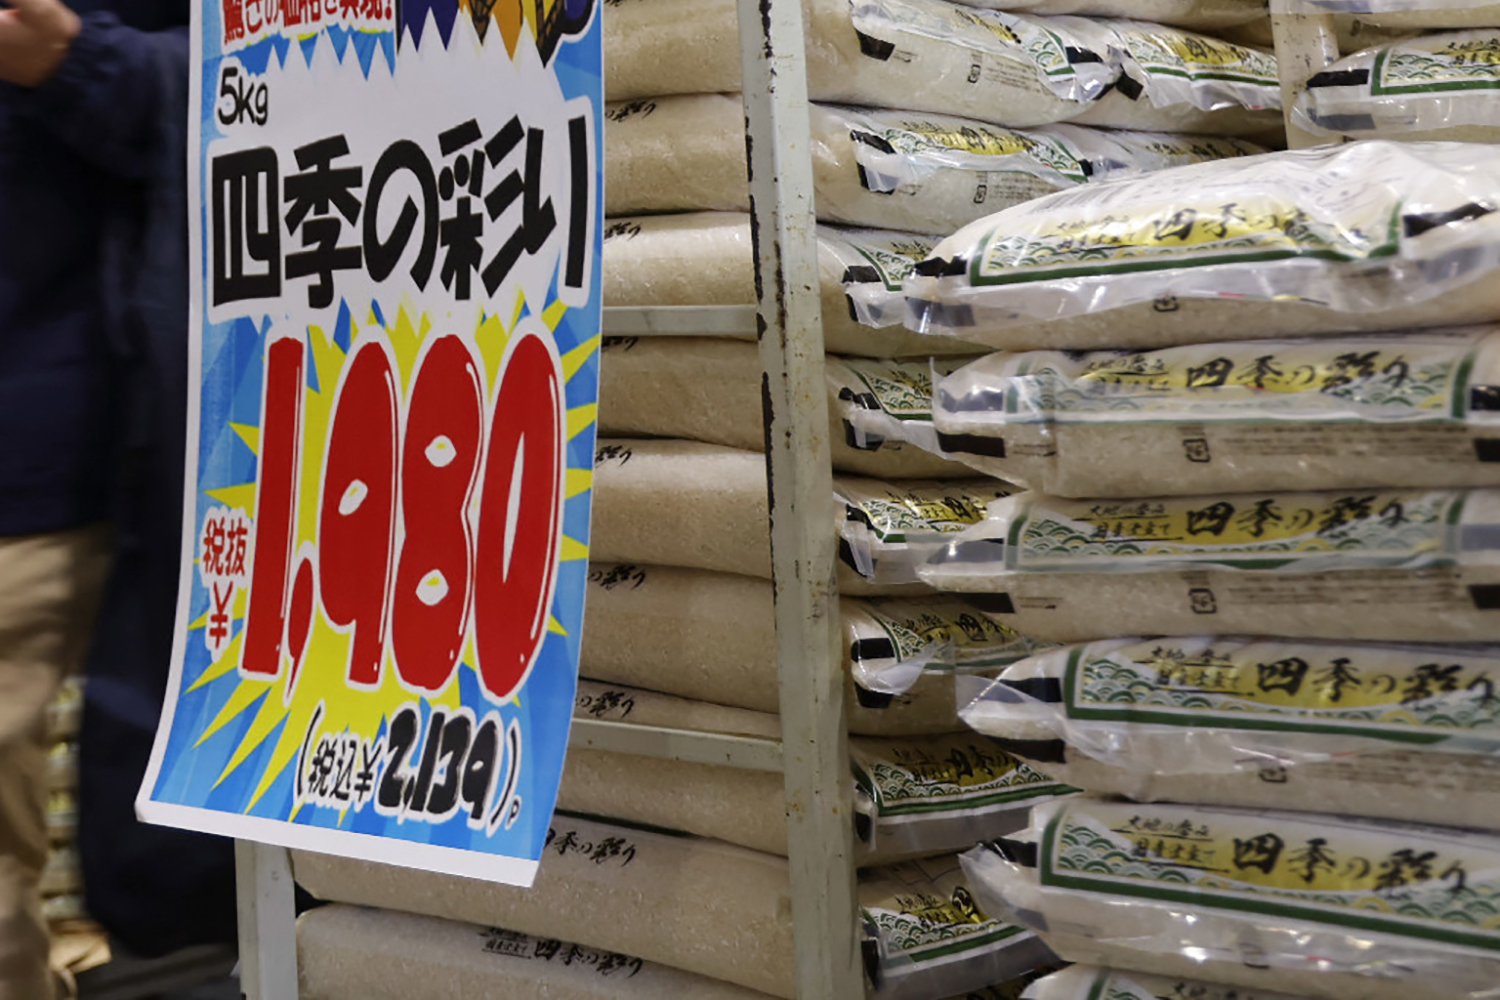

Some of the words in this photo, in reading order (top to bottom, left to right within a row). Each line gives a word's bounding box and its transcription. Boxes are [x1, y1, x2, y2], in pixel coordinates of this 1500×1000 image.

[217, 66, 269, 126] 5kg
[211, 114, 589, 309] 四季の彩り
[202, 516, 249, 579] 税抜
[240, 332, 562, 700] 1,980
